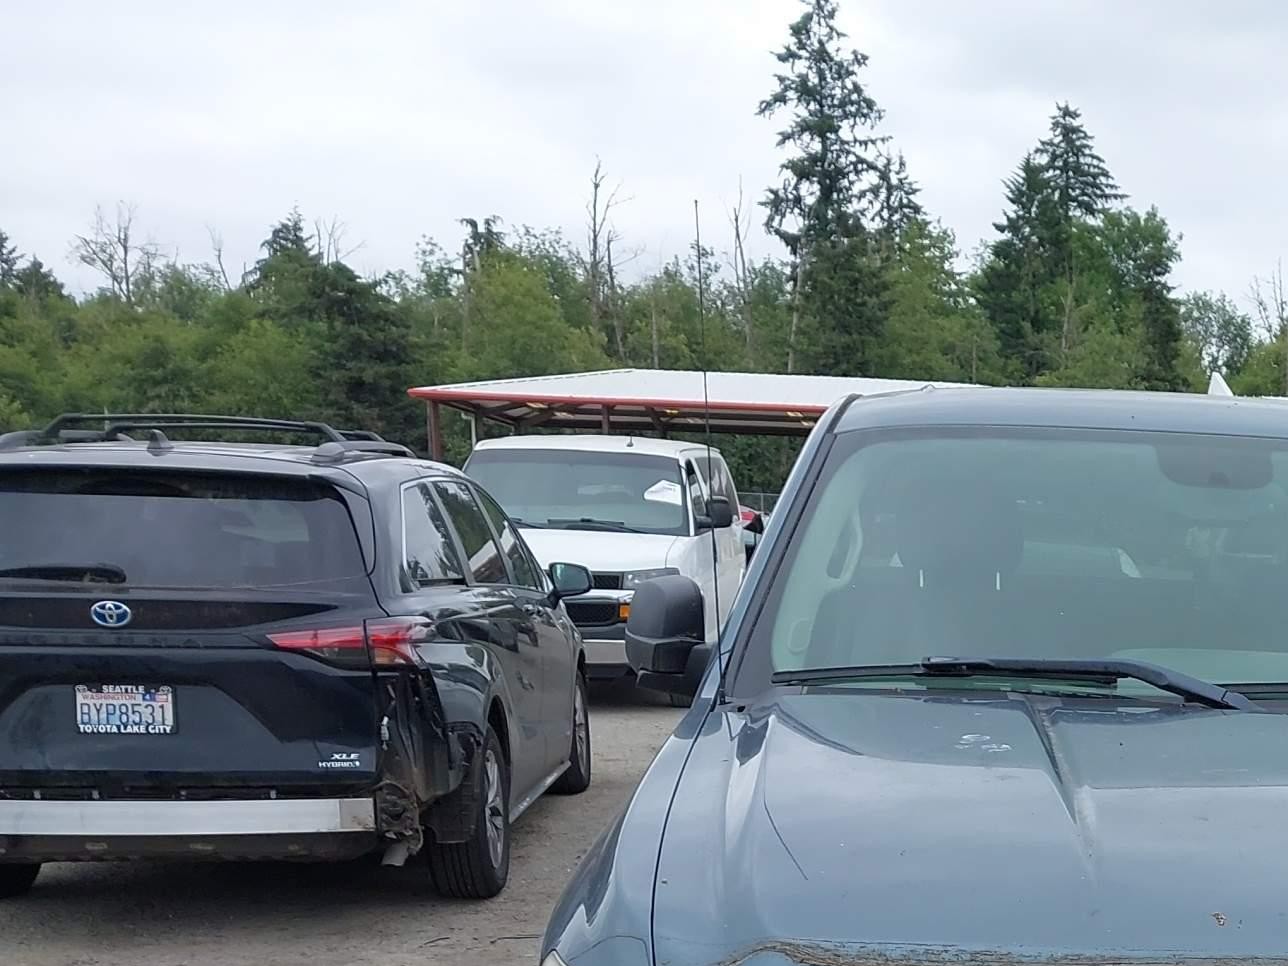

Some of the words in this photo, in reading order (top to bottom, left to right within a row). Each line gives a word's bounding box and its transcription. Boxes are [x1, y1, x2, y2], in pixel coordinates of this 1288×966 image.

[102, 685, 145, 693] SEATTLE
[81, 693, 137, 701] WASHINGTON
[80, 703, 165, 725] BYP8531
[79, 724, 119, 733] TOYOTA
[120, 724, 146, 733] LAKE
[148, 724, 171, 733] CITY
